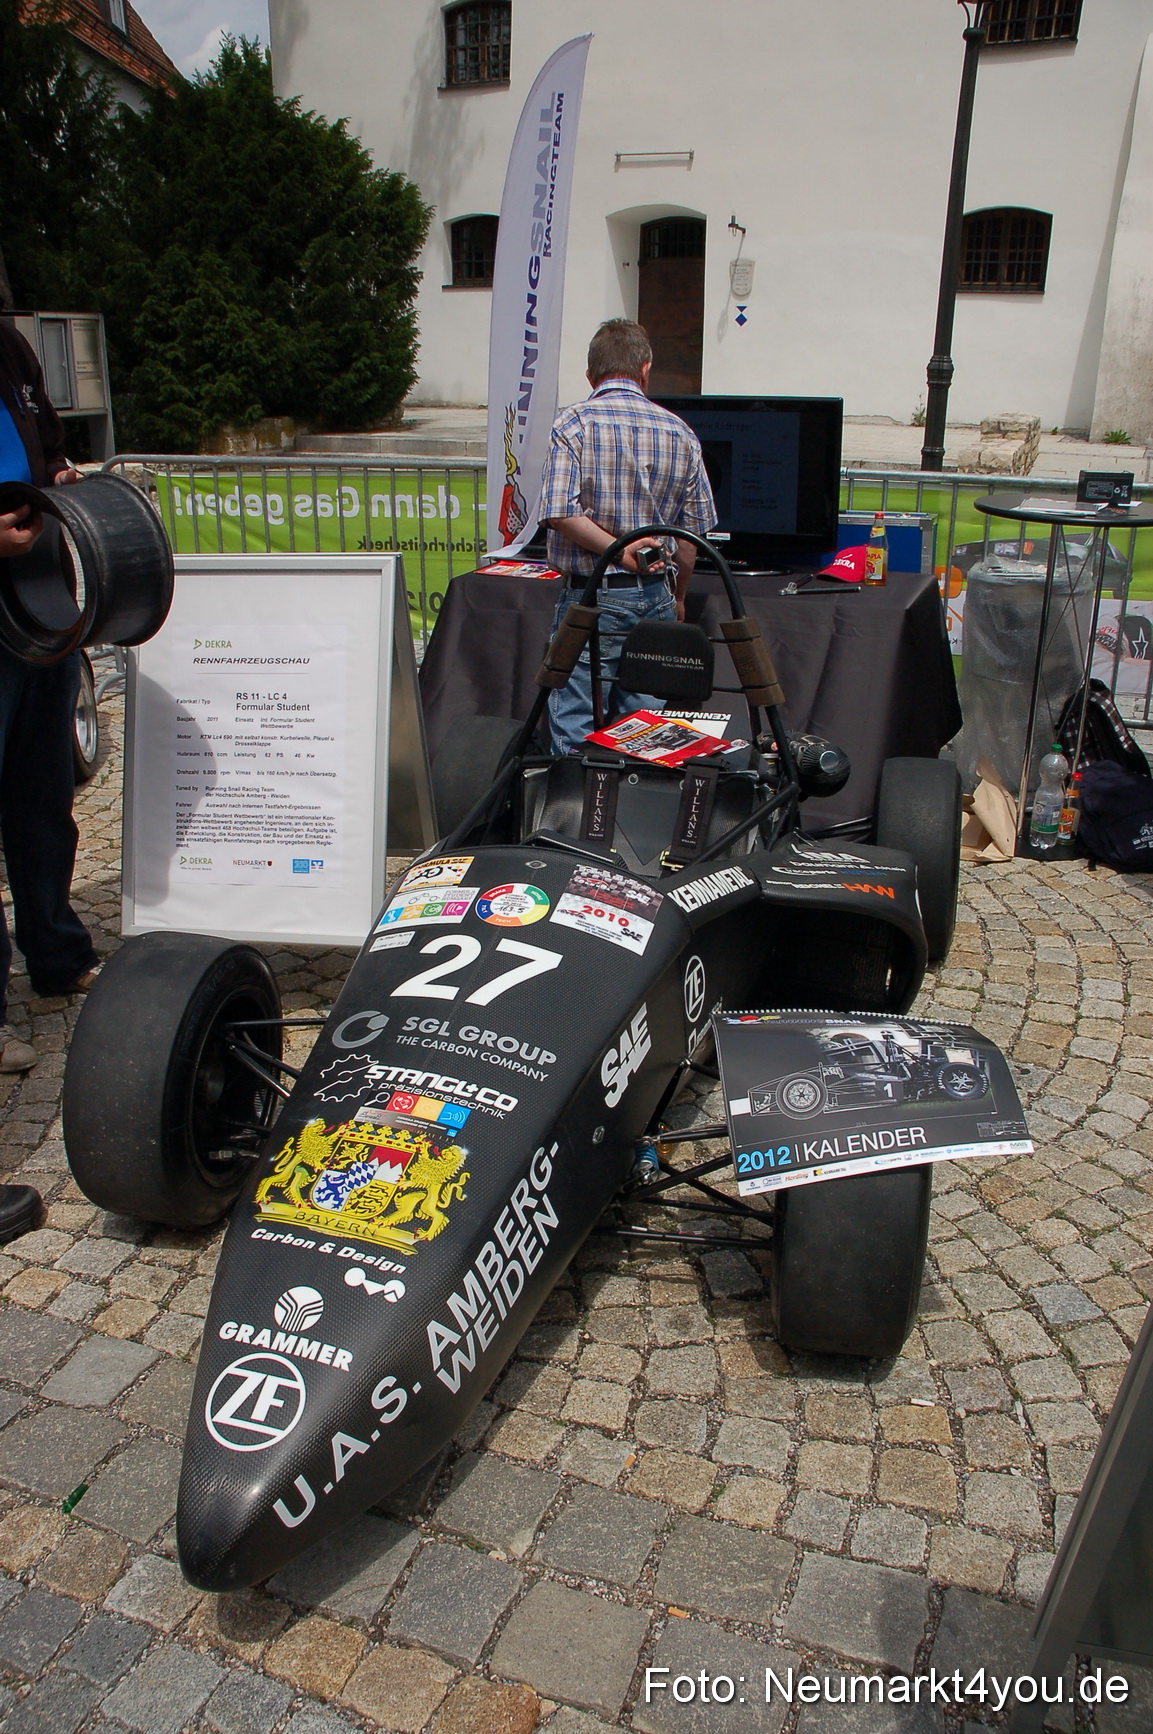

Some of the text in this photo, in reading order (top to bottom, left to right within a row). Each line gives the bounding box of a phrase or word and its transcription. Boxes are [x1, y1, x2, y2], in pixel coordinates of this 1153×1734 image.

[543, 92, 565, 258] RACINGTEAM
[516, 92, 556, 475] NNINGSNAIL
[626, 652, 704, 666] RUNNINGSNAIL
[593, 774, 607, 832] WILLANS
[686, 779, 705, 838] WILLANS
[581, 905, 630, 927] 2010
[666, 866, 754, 913] KENNAMETAL
[621, 928, 643, 943] SAE
[390, 934, 564, 1006] 27
[684, 958, 705, 1019] ZF
[396, 1035, 549, 1082] THE CARBON COMPANY
[402, 1016, 557, 1066] SGL GROUP
[601, 1002, 652, 1108] SAE
[884, 1082, 893, 1098] 1
[736, 1145, 792, 1174] 2012
[803, 1126, 927, 1162] KALENDER
[250, 1227, 407, 1274] Carbon & Design
[293, 1209, 378, 1238] BAYERN
[426, 1142, 559, 1371] AMBERG-
[436, 1195, 559, 1395] WEIDEN
[218, 1320, 355, 1372] GRAMMER
[209, 1361, 303, 1444] ZF
[273, 1374, 423, 1528] U.A.S.
